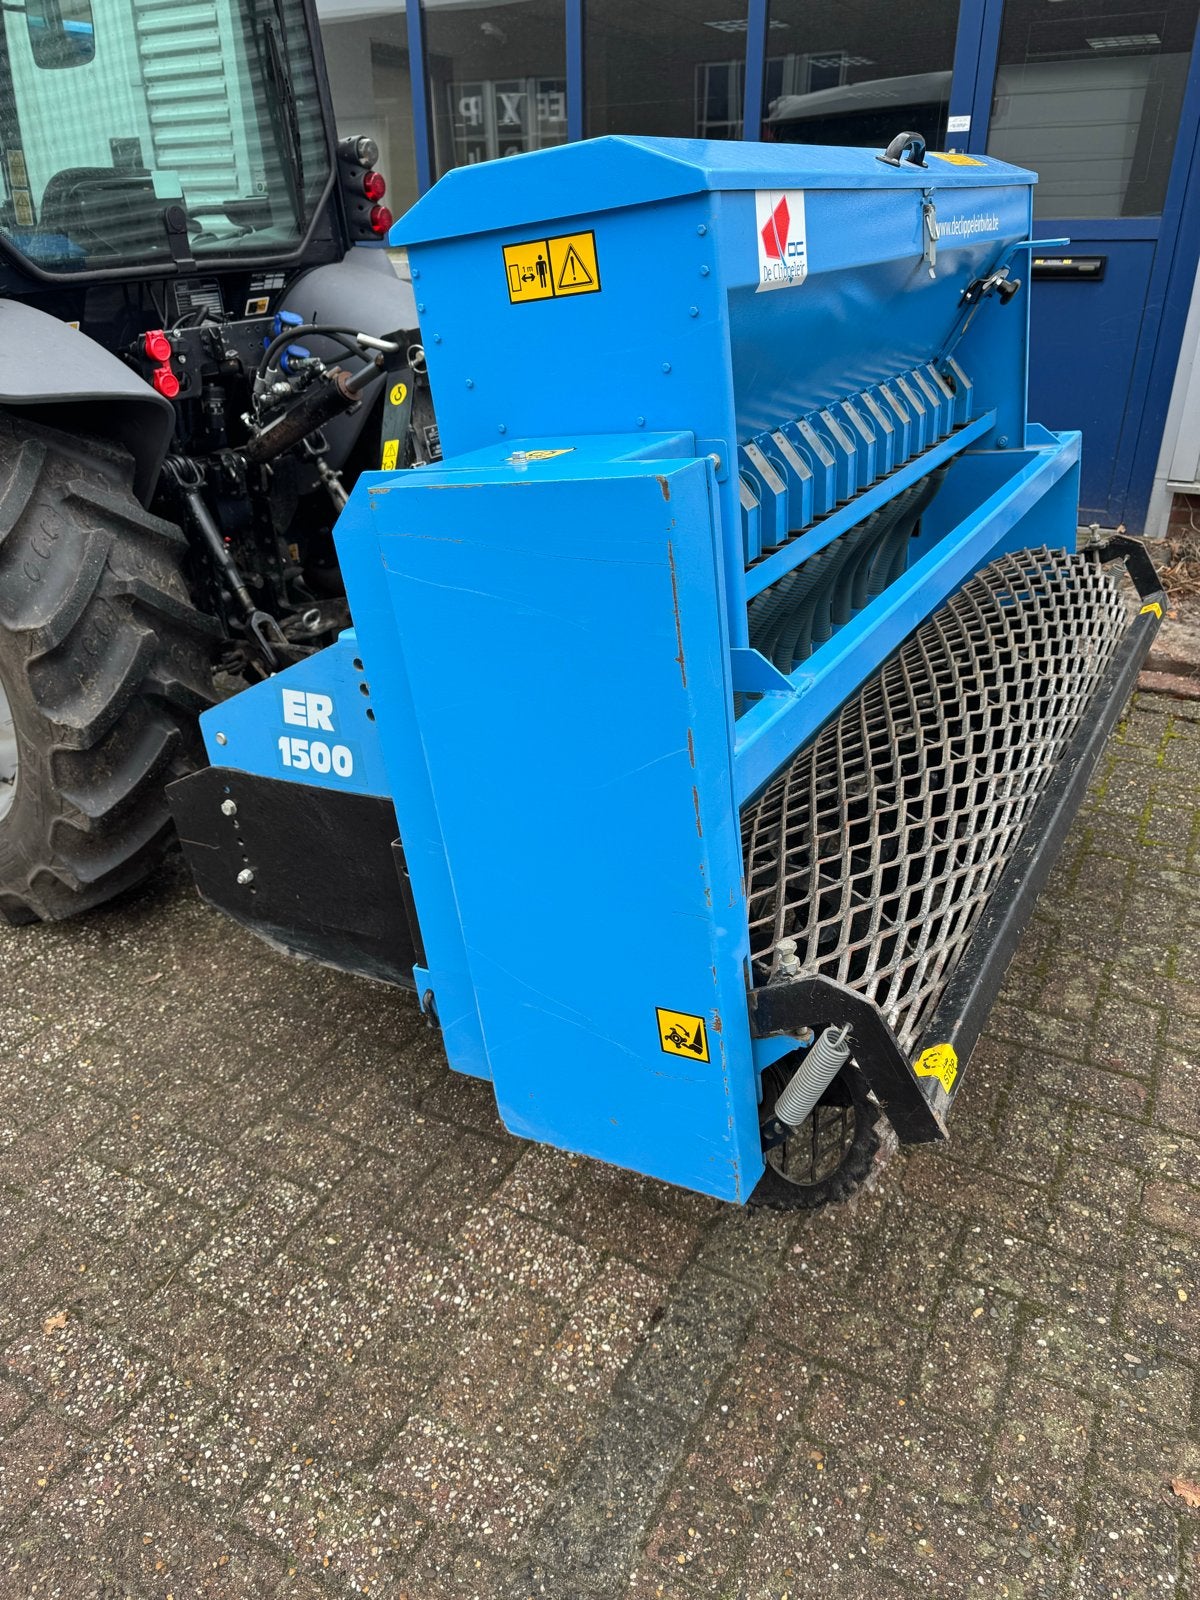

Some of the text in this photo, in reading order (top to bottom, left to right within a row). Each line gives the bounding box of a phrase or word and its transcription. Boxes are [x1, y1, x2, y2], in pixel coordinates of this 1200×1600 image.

[763, 265, 772, 281] De
[282, 688, 335, 732] ER
[278, 736, 353, 778] 1500
